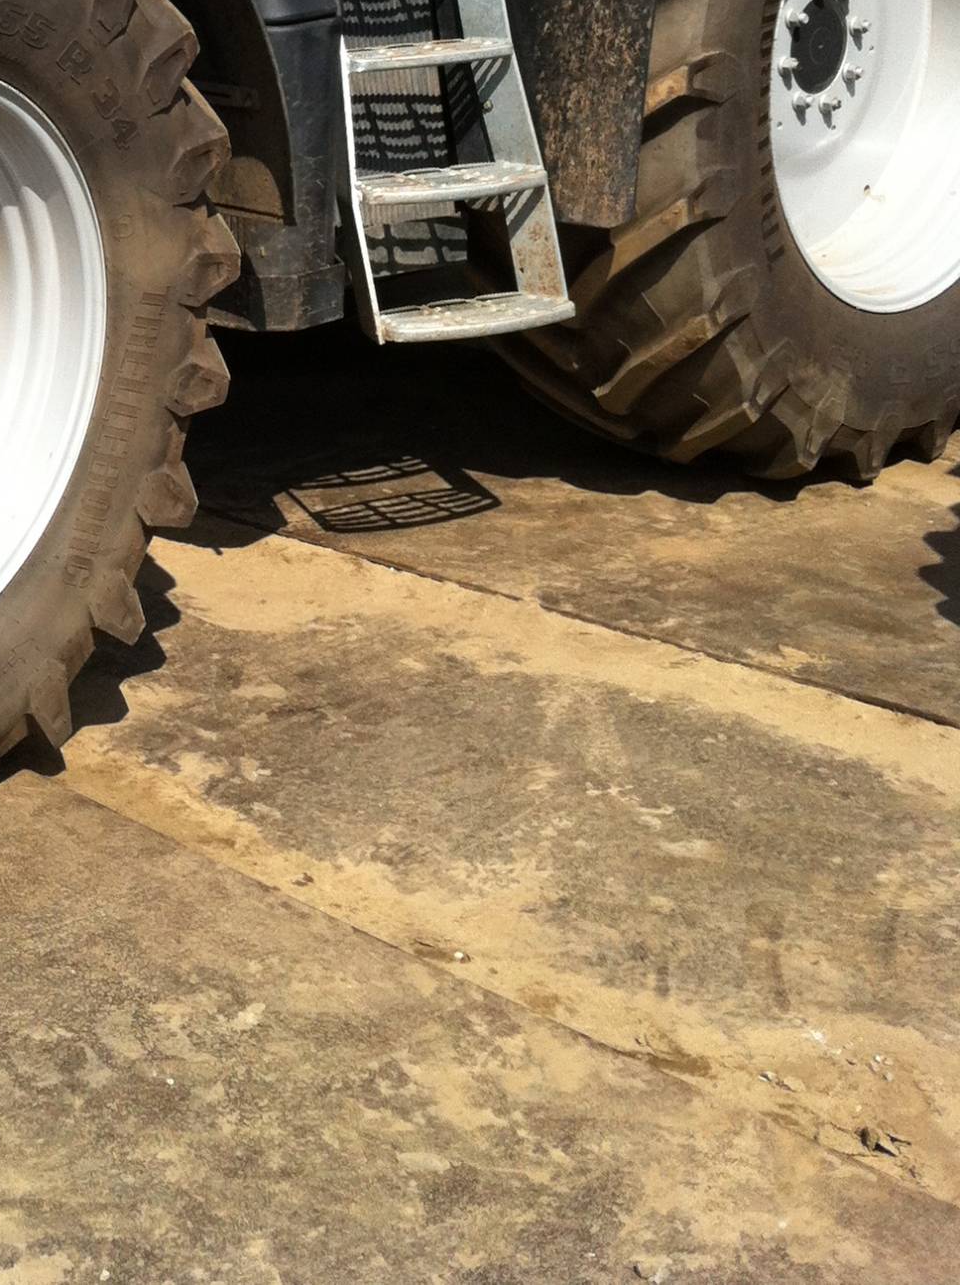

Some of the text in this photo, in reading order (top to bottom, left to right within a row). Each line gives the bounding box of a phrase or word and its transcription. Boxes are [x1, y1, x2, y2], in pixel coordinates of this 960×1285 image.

[55, 39, 96, 84] R
[92, 76, 139, 153] 34
[62, 285, 170, 591] TRELLEBORG
